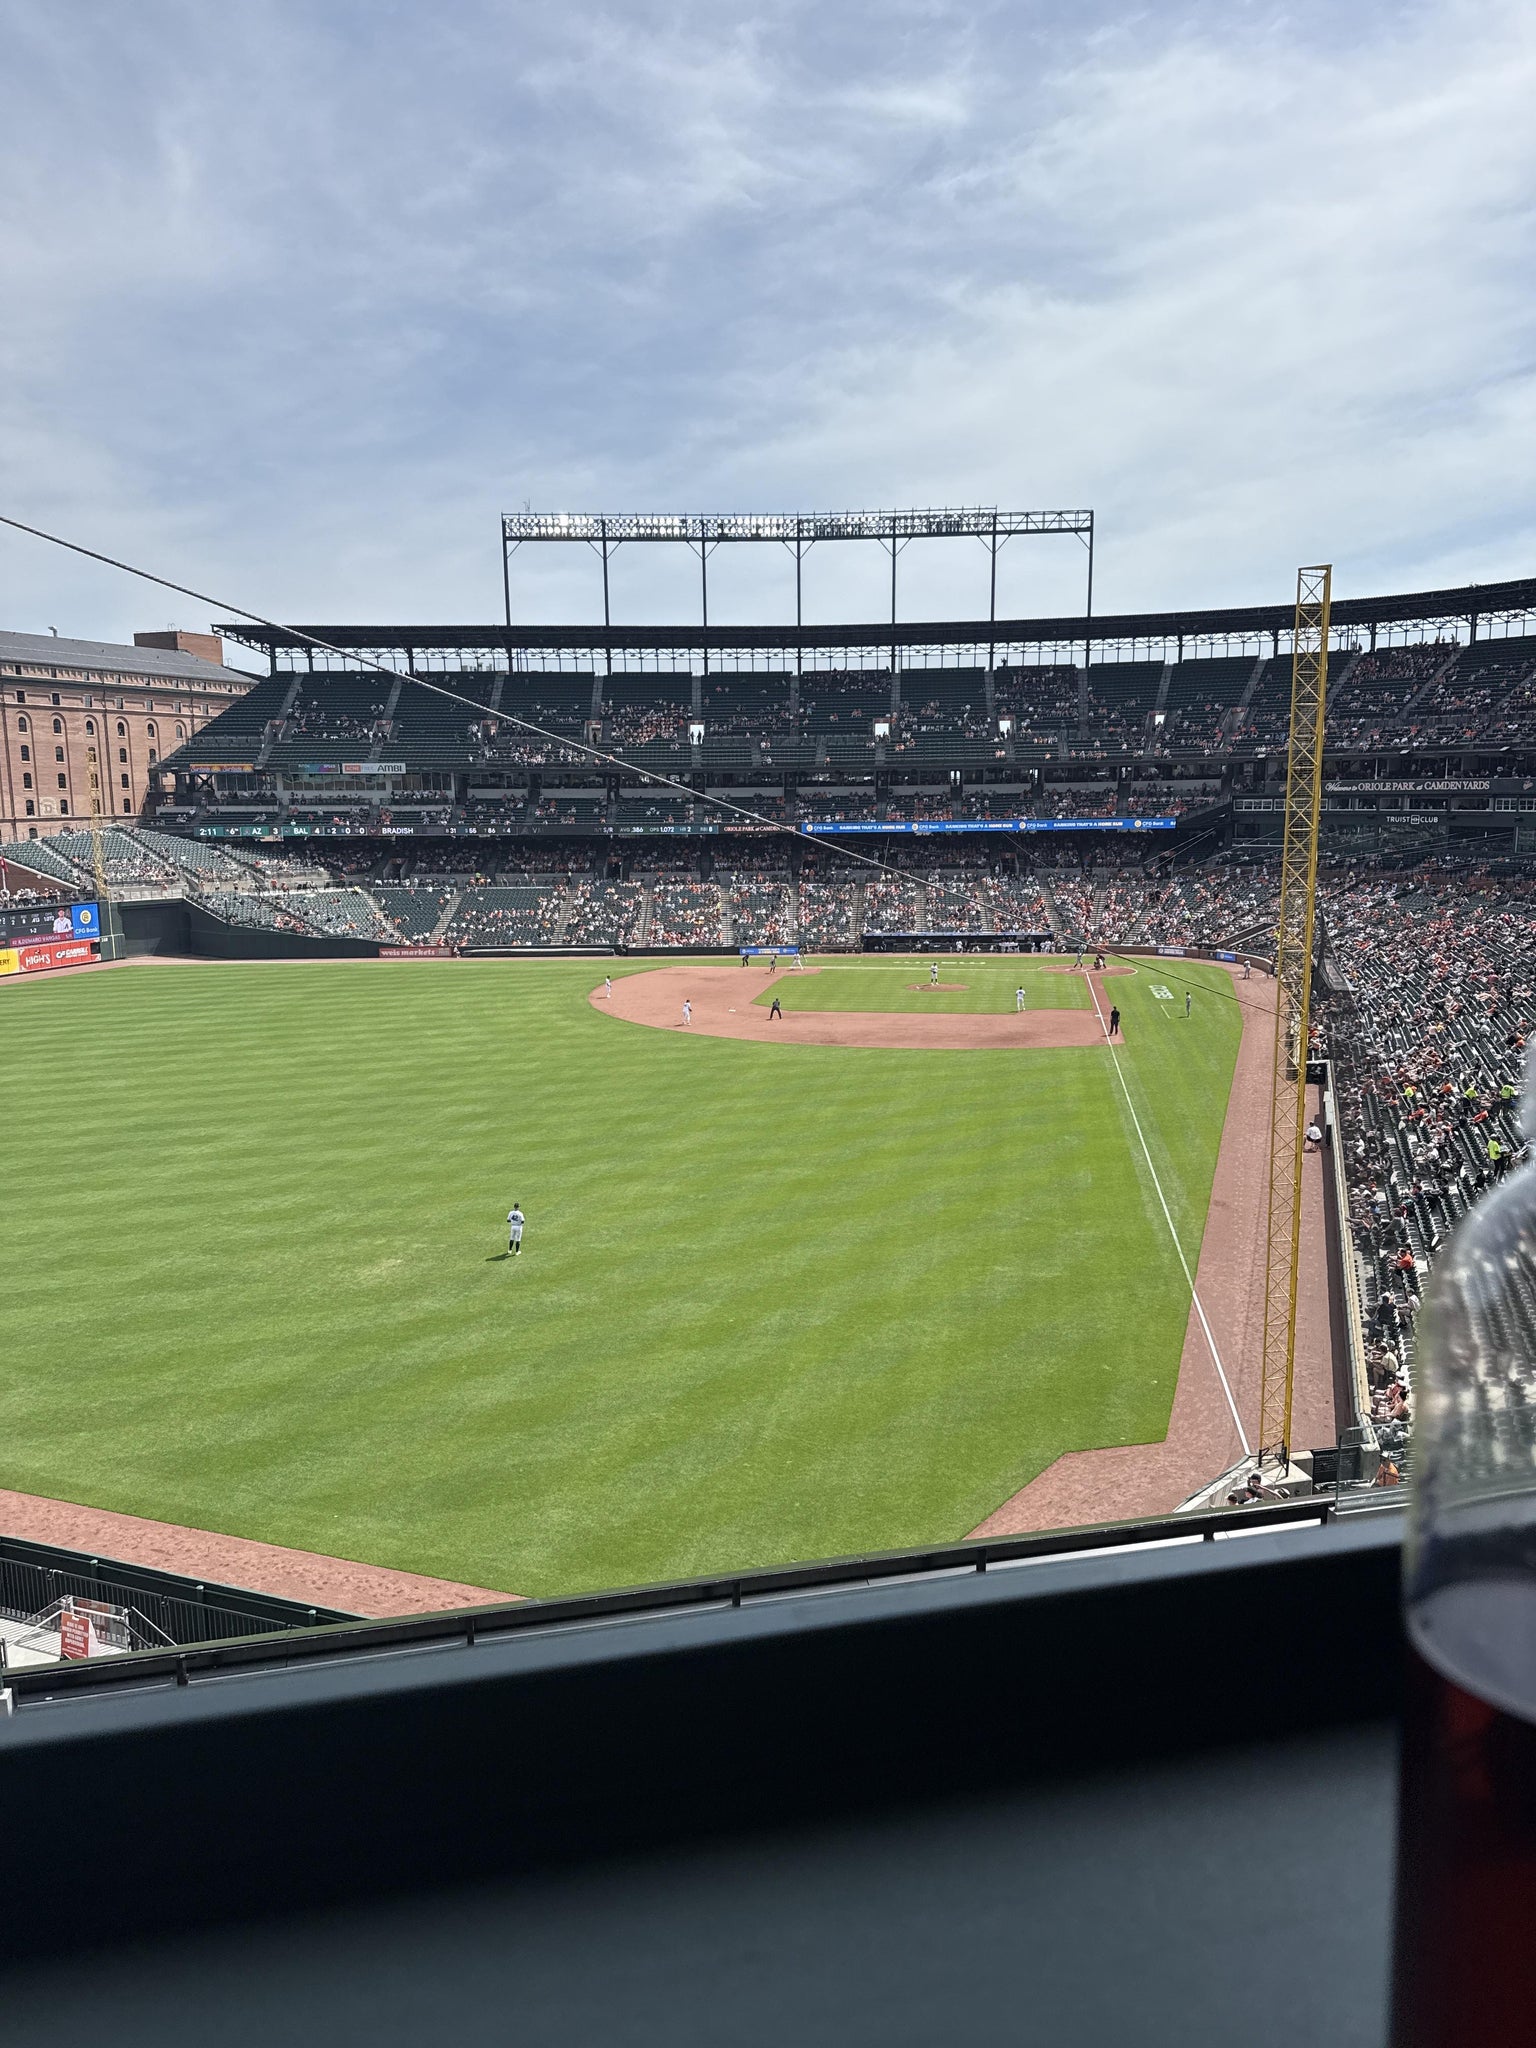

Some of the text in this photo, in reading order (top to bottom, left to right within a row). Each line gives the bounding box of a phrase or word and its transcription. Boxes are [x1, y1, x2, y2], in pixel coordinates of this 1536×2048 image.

[1325, 782, 1352, 792] Welcome
[1358, 782, 1392, 791] ORIOLE
[1392, 782, 1415, 791] PARK
[1424, 782, 1462, 790] CAMDEN
[1462, 780, 1490, 790] YARDS
[26, 954, 50, 967] HIGH'S
